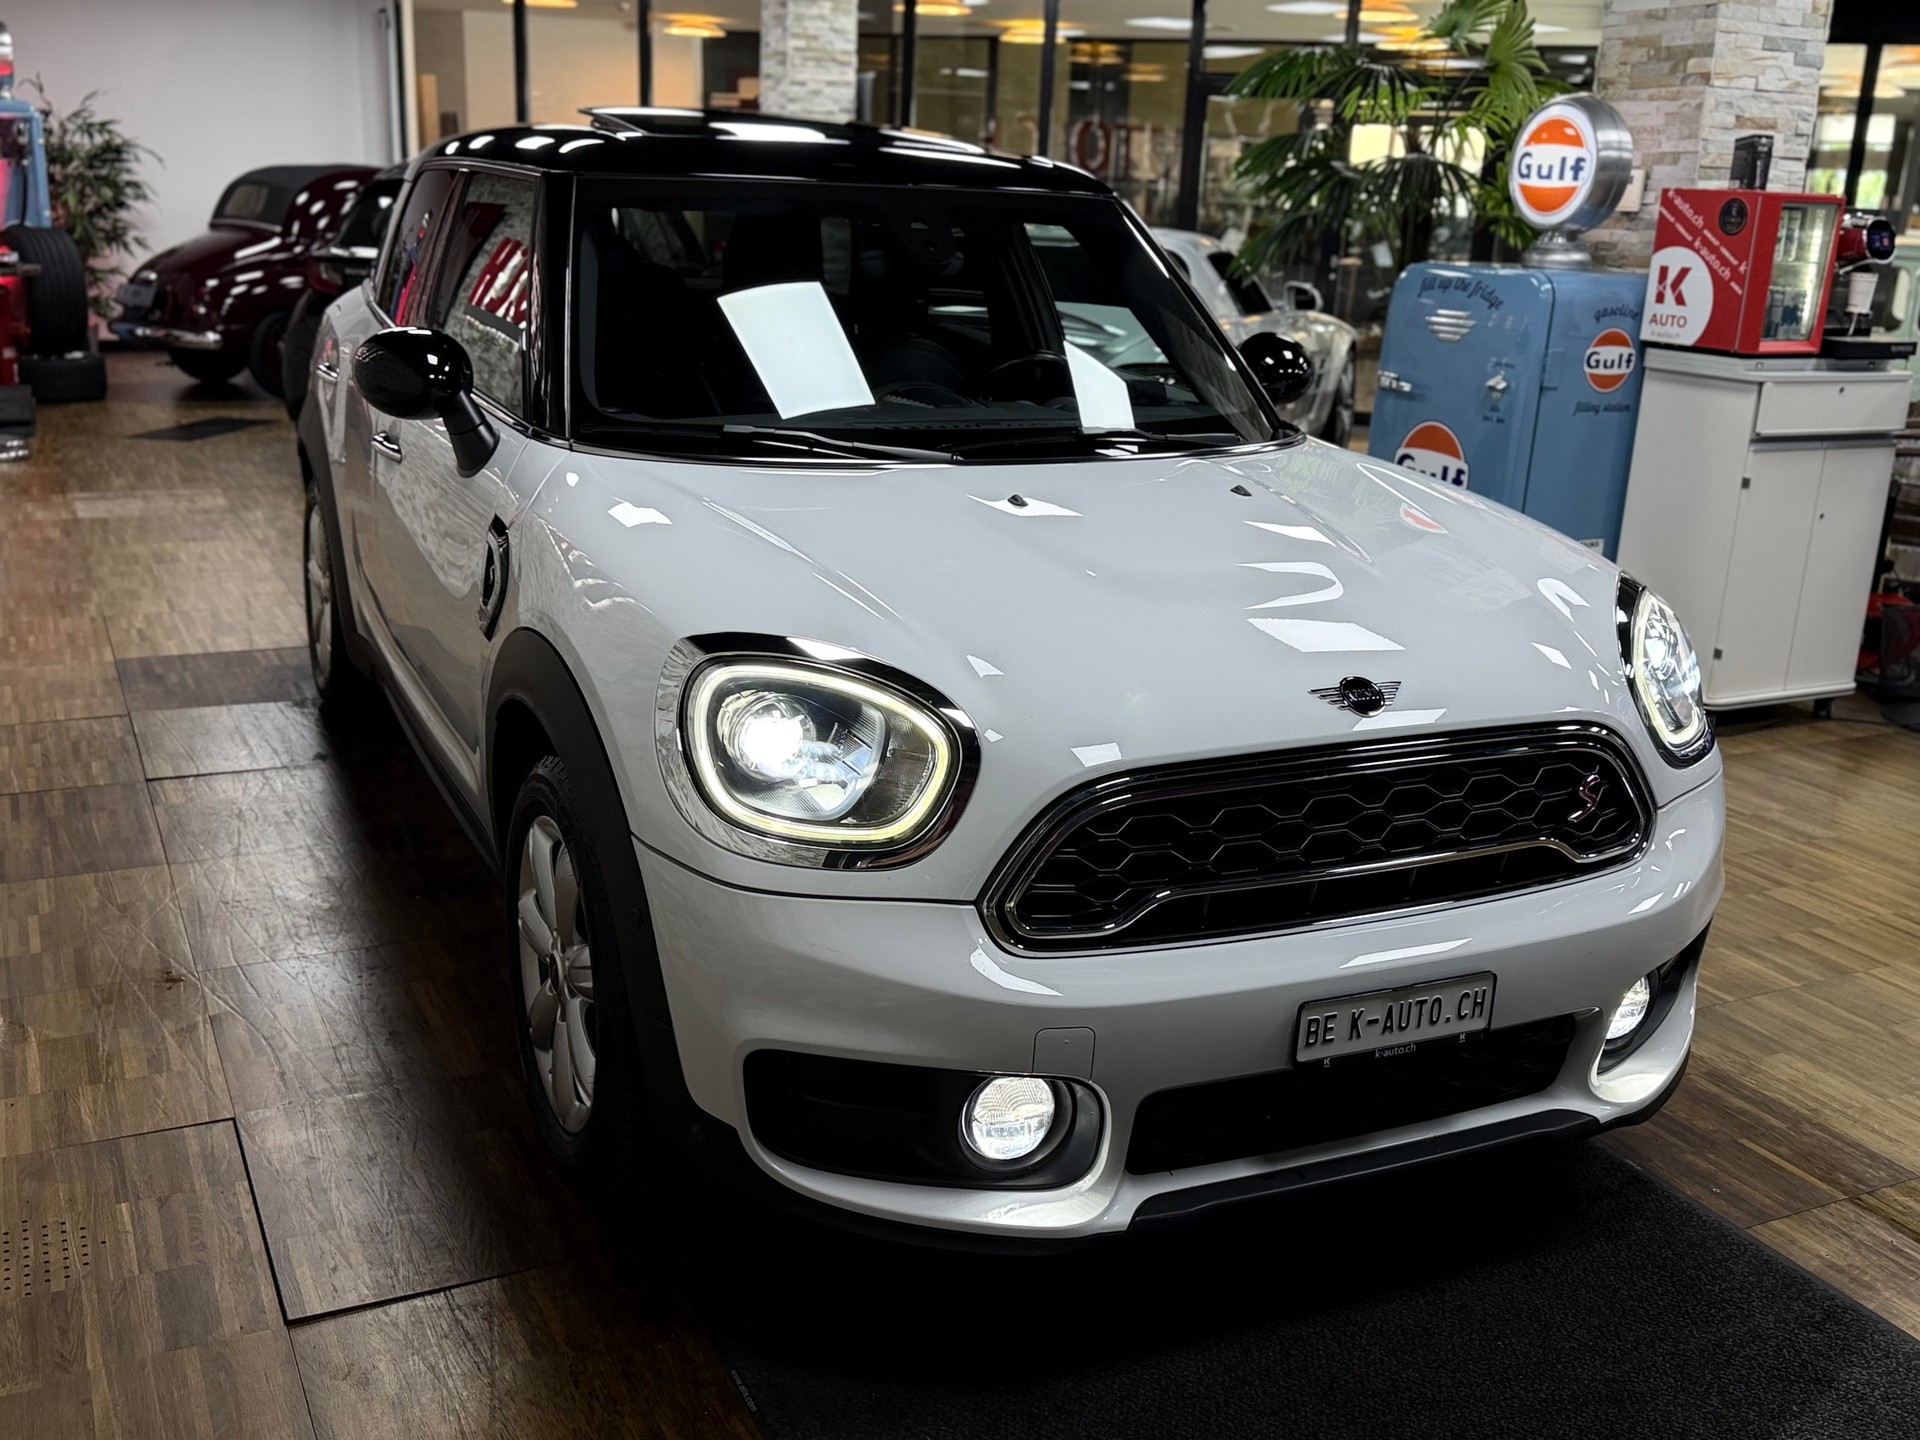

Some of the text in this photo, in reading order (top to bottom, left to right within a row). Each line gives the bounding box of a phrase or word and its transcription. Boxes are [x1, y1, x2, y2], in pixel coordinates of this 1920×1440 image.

[1517, 151, 1586, 181] Gulf
[1692, 236, 1731, 281] k-auto.ch
[1417, 277, 1504, 311] fill up the fridge
[1654, 265, 1693, 306] K
[1594, 304, 1640, 325] gasoline
[1649, 313, 1687, 328] AUTO
[1586, 351, 1635, 369] Gulf
[1305, 987, 1488, 1047] BE K-AUTO.CH
[1375, 1042, 1417, 1059] k-auto.ch
